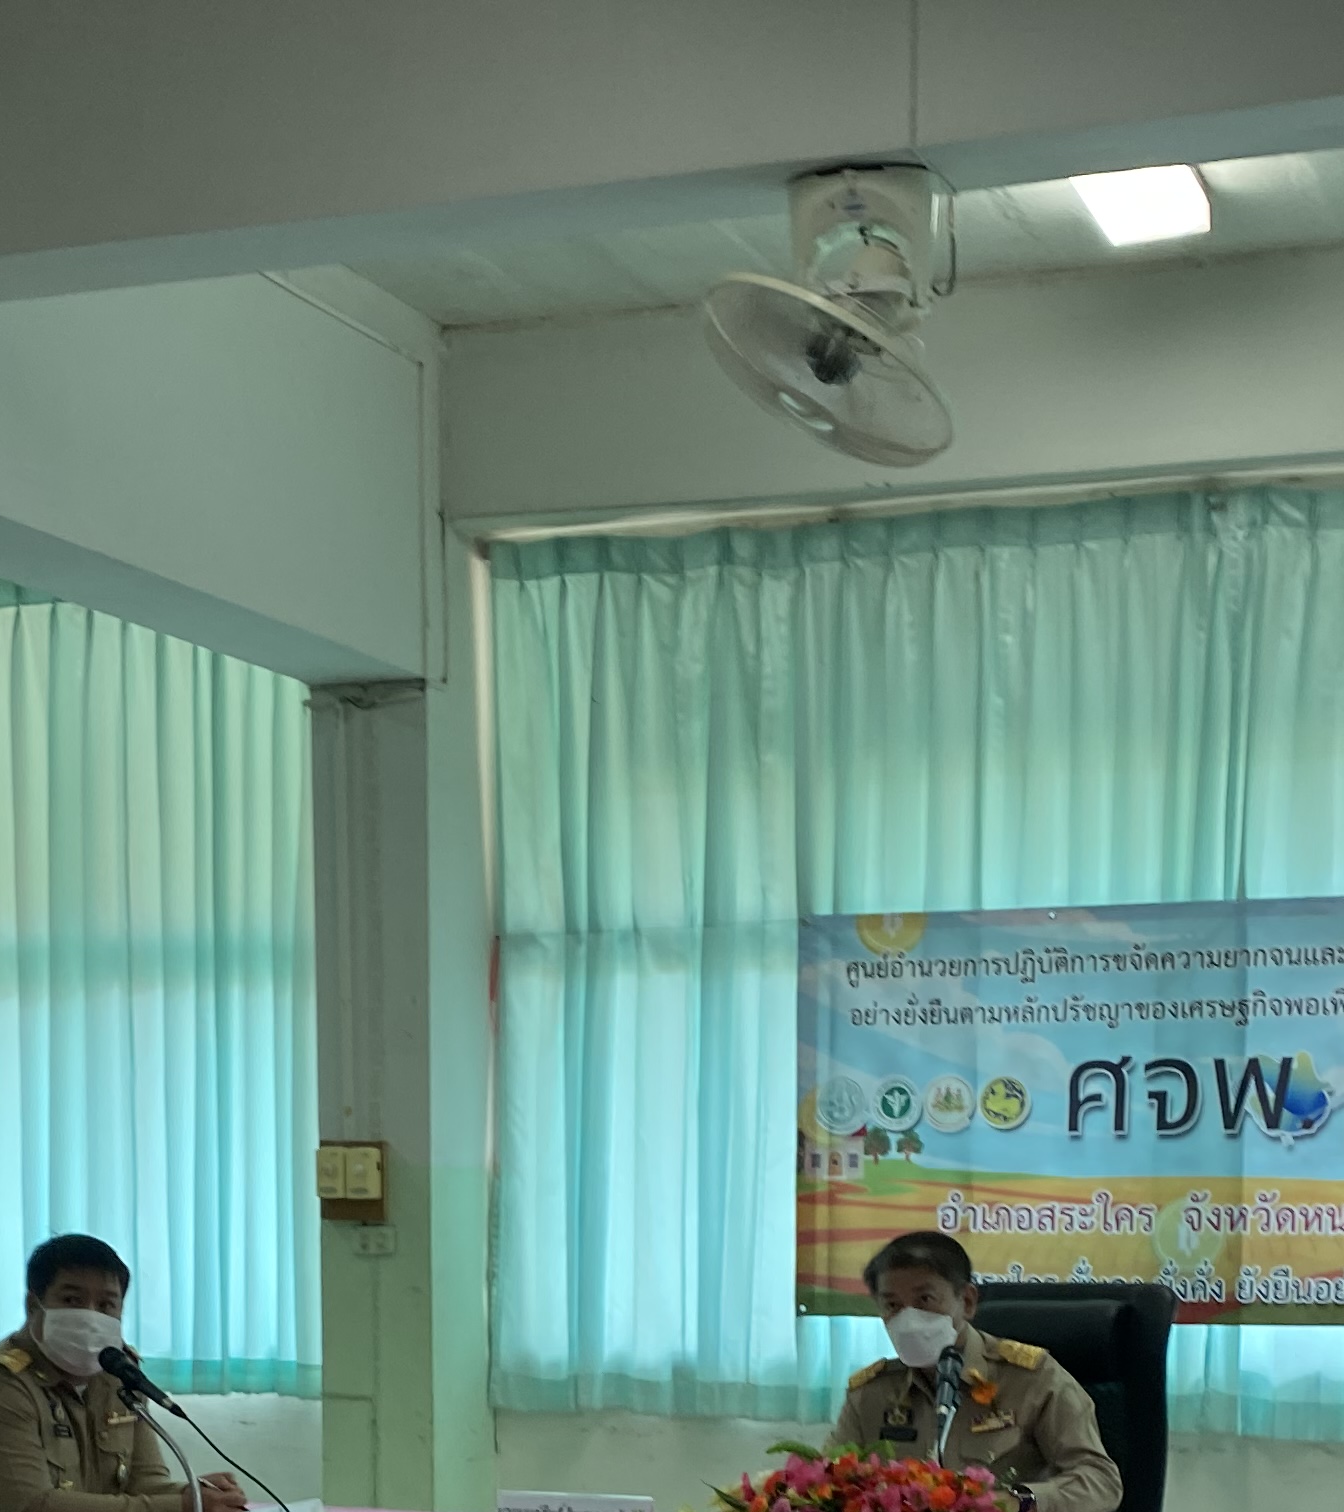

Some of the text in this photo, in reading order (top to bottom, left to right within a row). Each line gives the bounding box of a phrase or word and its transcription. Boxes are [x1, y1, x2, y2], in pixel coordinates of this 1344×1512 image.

[937, 1190, 1156, 1234] อำเภอสระใคร
